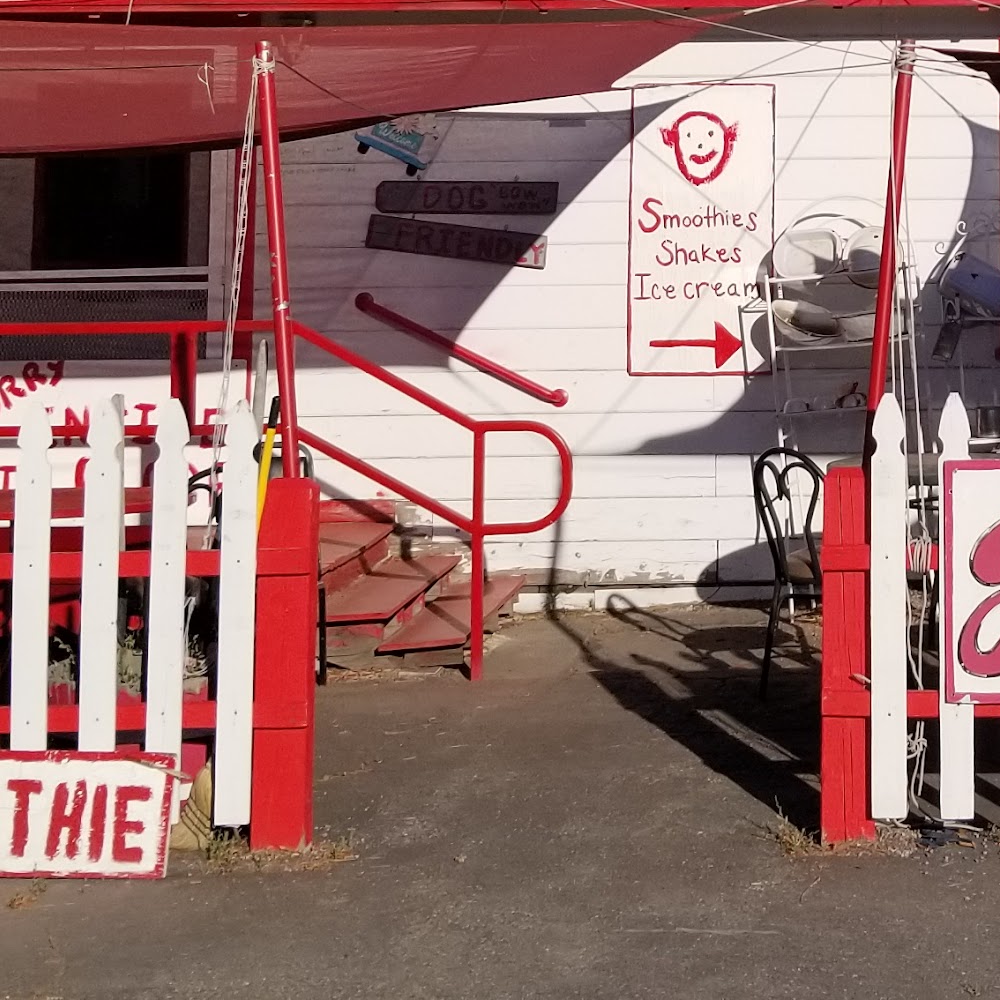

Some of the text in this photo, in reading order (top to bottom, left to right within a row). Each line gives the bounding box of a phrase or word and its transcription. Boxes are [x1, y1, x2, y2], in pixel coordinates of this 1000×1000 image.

[422, 184, 488, 211] DOG
[637, 197, 758, 234] Smoothies
[395, 222, 546, 266] FRIENDLY
[655, 239, 742, 267] Shakes
[633, 273, 760, 301] Ice cream
